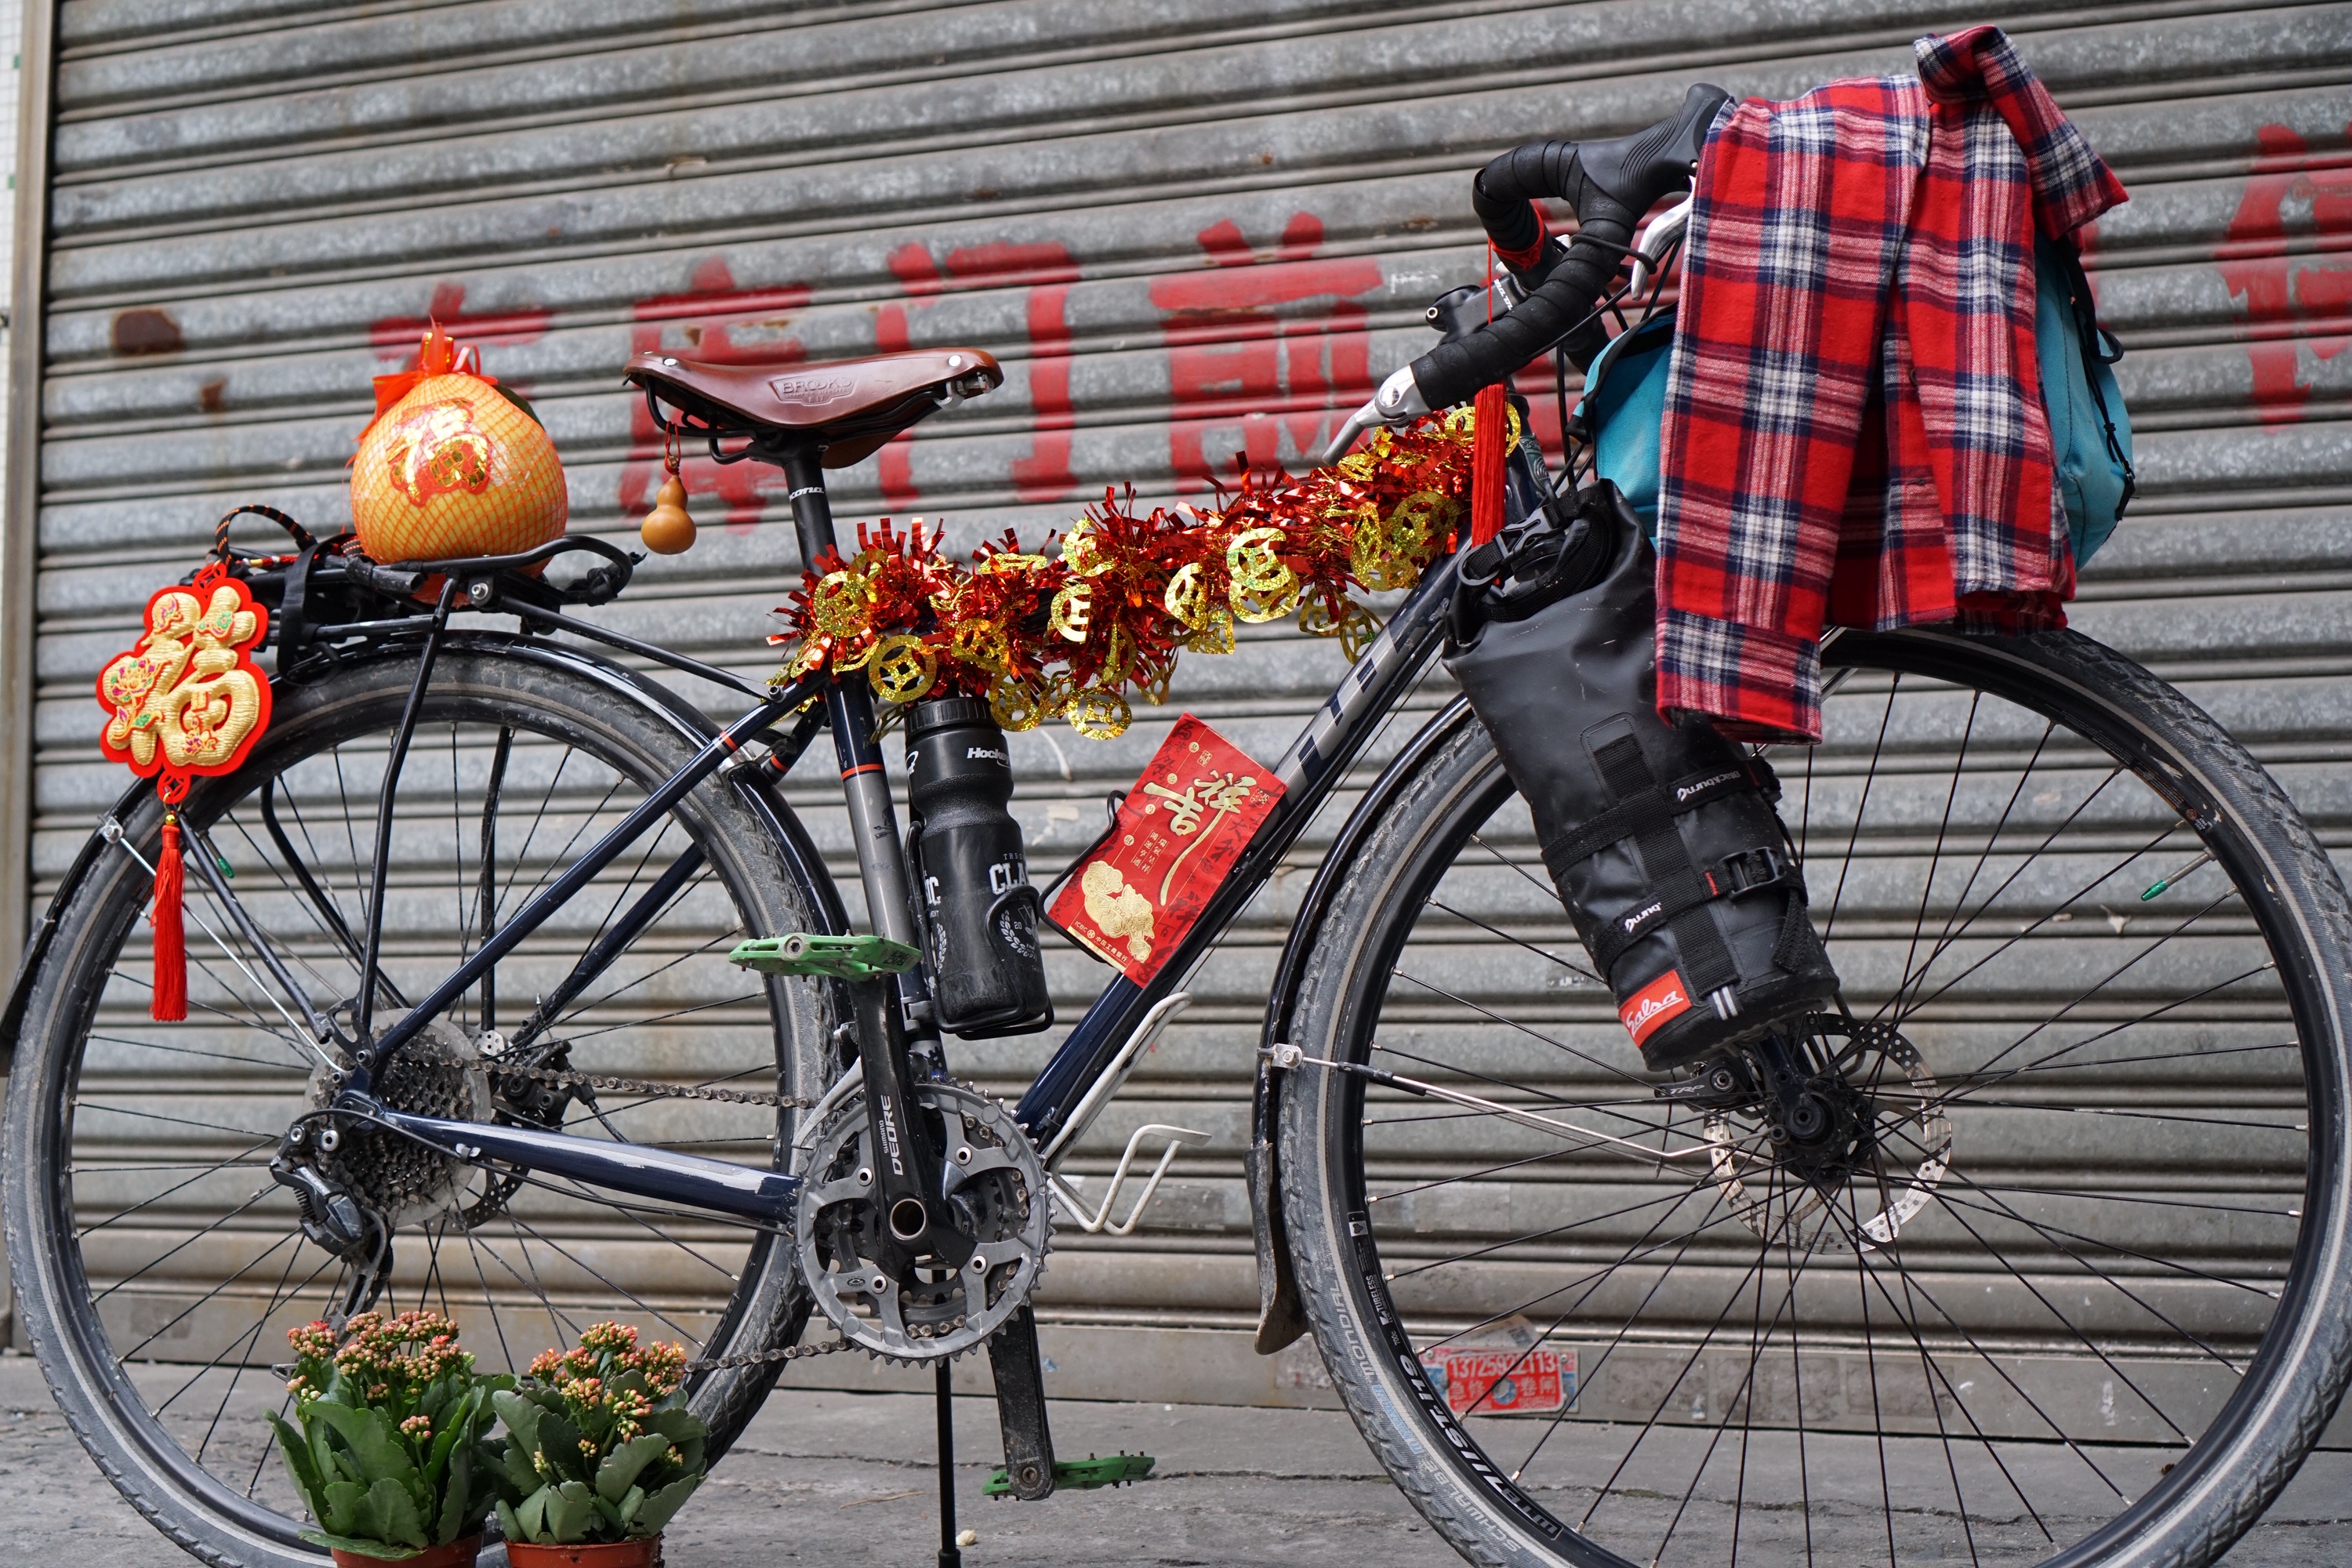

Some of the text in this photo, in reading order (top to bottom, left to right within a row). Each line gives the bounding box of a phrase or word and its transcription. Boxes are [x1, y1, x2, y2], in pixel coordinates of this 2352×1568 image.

[781, 376, 851, 394] BROOKS
[102, 585, 260, 767] 福
[1683, 770, 1741, 795] Blackburn
[1626, 990, 1684, 1038] Salsa
[1670, 1084, 1705, 1094] TRP
[879, 1120, 889, 1154] SHIMANO
[880, 1094, 904, 1175] DEORE
[1366, 1275, 1385, 1313] TUBELESS
[1330, 1279, 1374, 1376] MONDIAL
[1420, 1454, 1522, 1552] SCHWALBE
